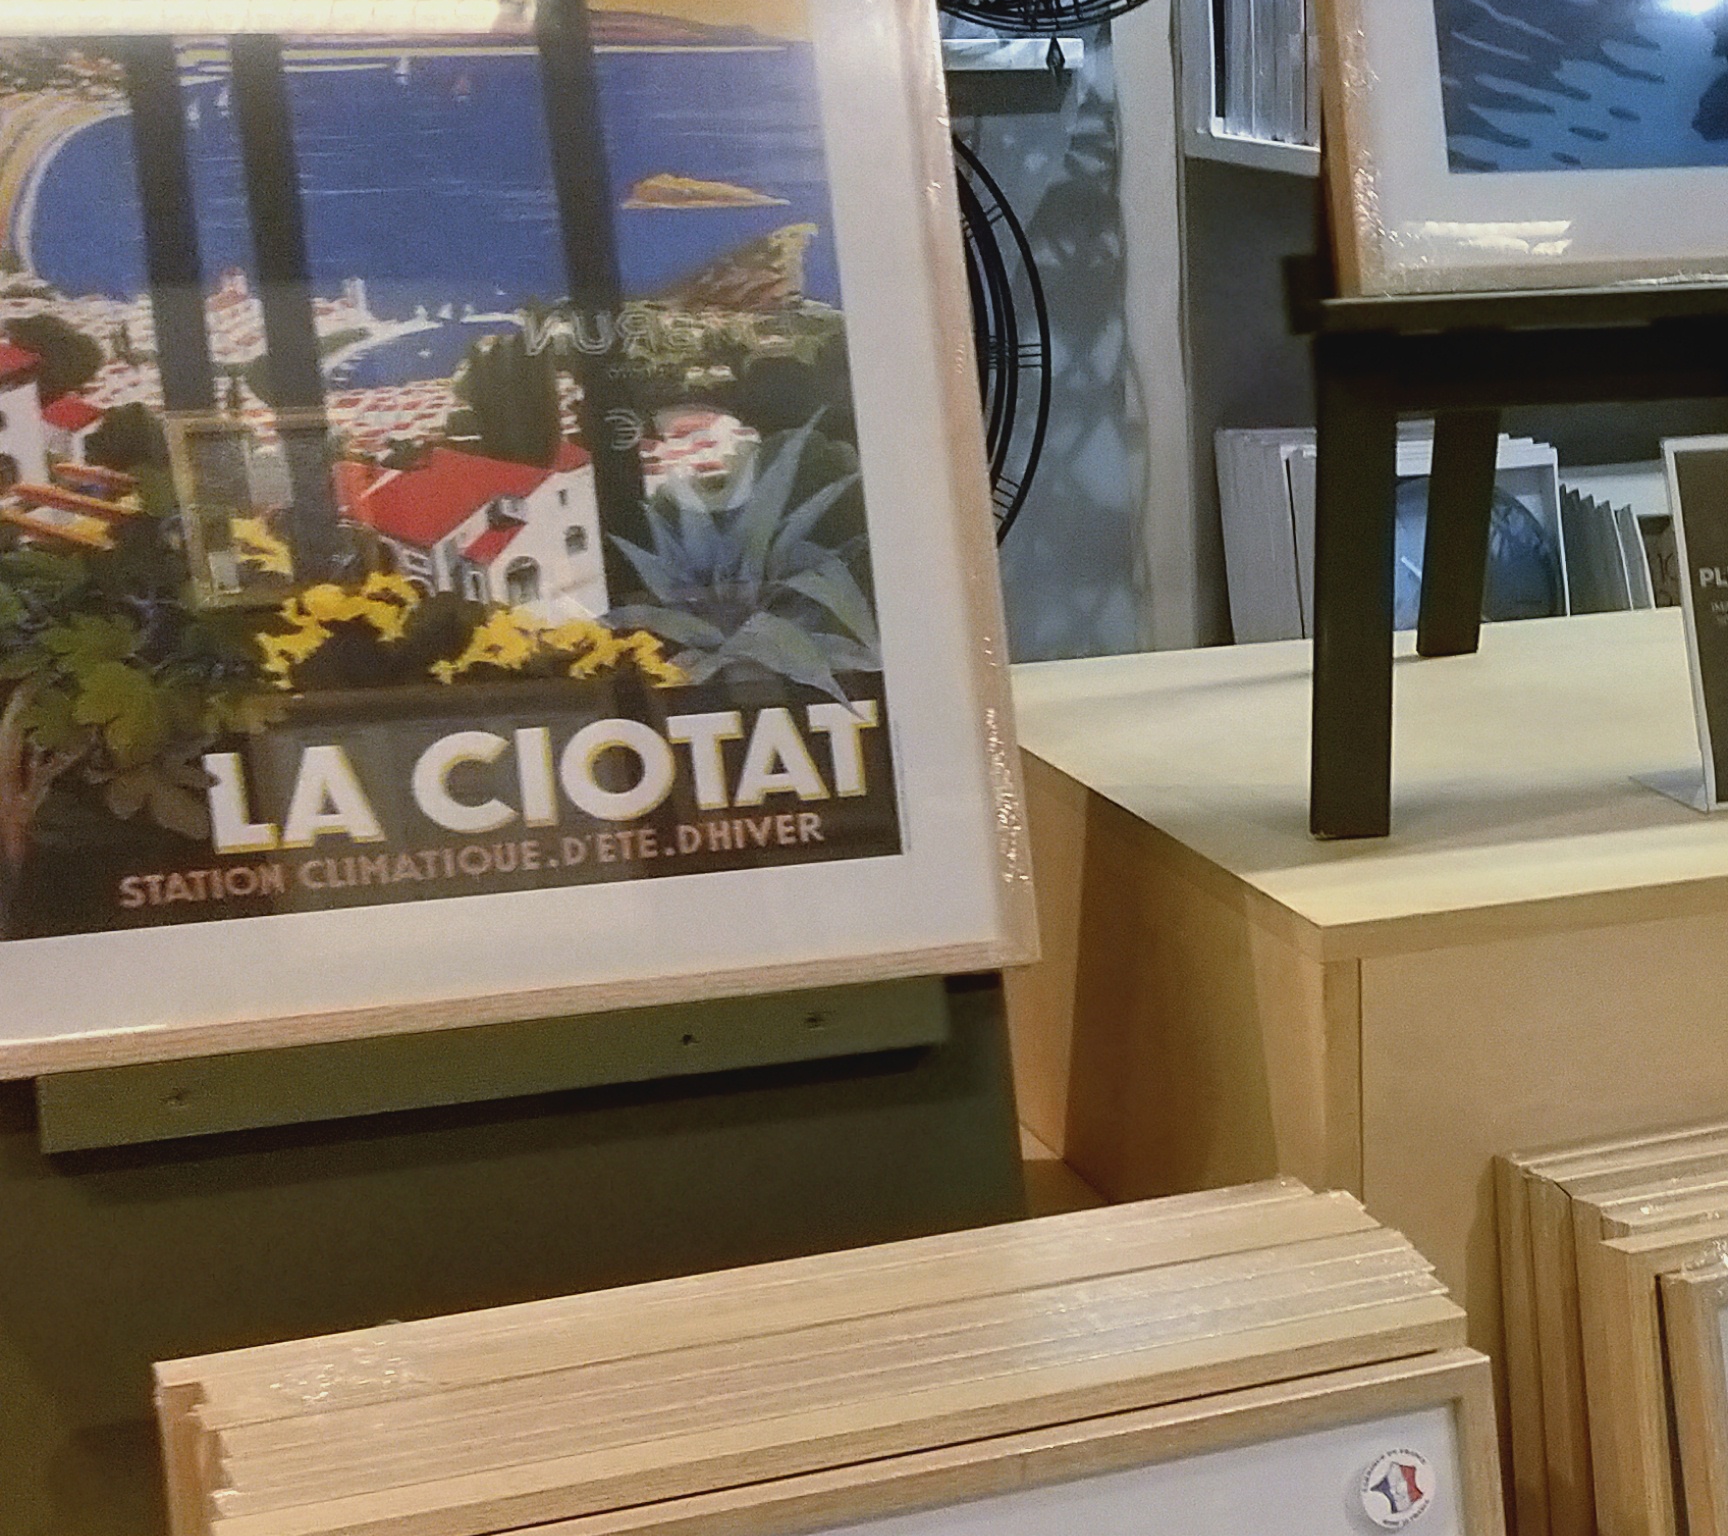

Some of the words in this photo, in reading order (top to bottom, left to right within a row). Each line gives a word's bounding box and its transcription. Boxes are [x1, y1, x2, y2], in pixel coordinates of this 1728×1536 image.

[204, 744, 386, 856] LA
[410, 699, 878, 834] CIOTAT
[118, 866, 286, 910] STATION
